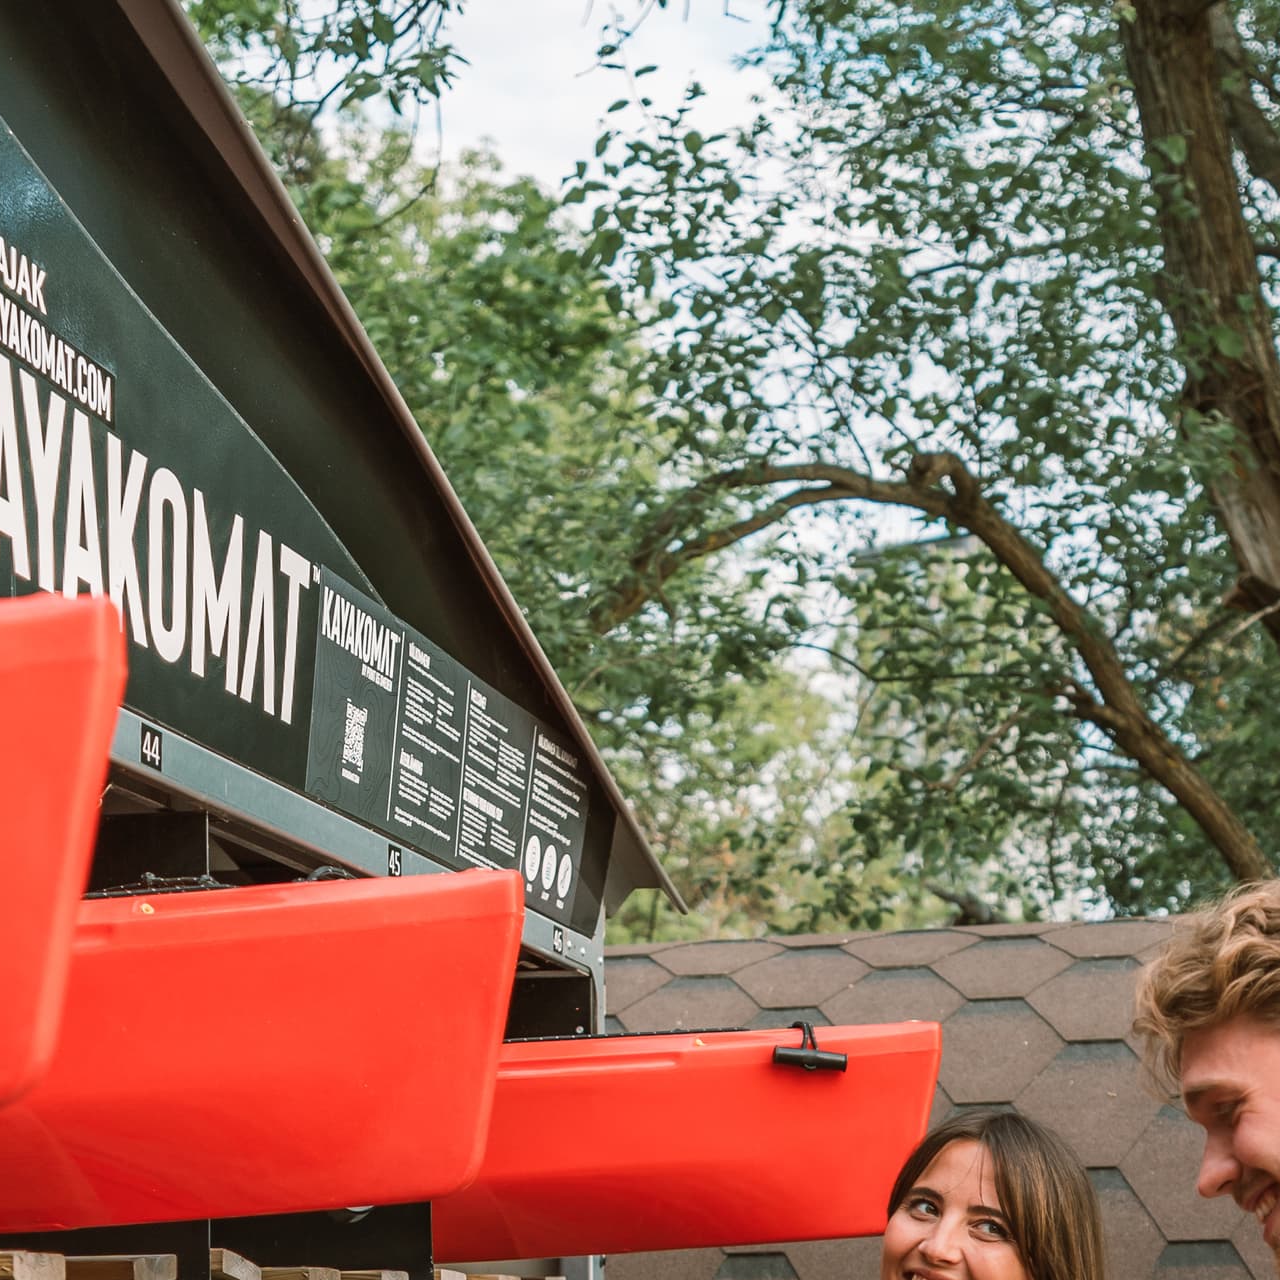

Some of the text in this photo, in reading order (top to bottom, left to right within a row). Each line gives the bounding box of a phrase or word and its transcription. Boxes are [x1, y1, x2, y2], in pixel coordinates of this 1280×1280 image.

[322, 586, 399, 679] KAYAKOMAT
[142, 731, 160, 766] 44
[389, 849, 400, 876] 45
